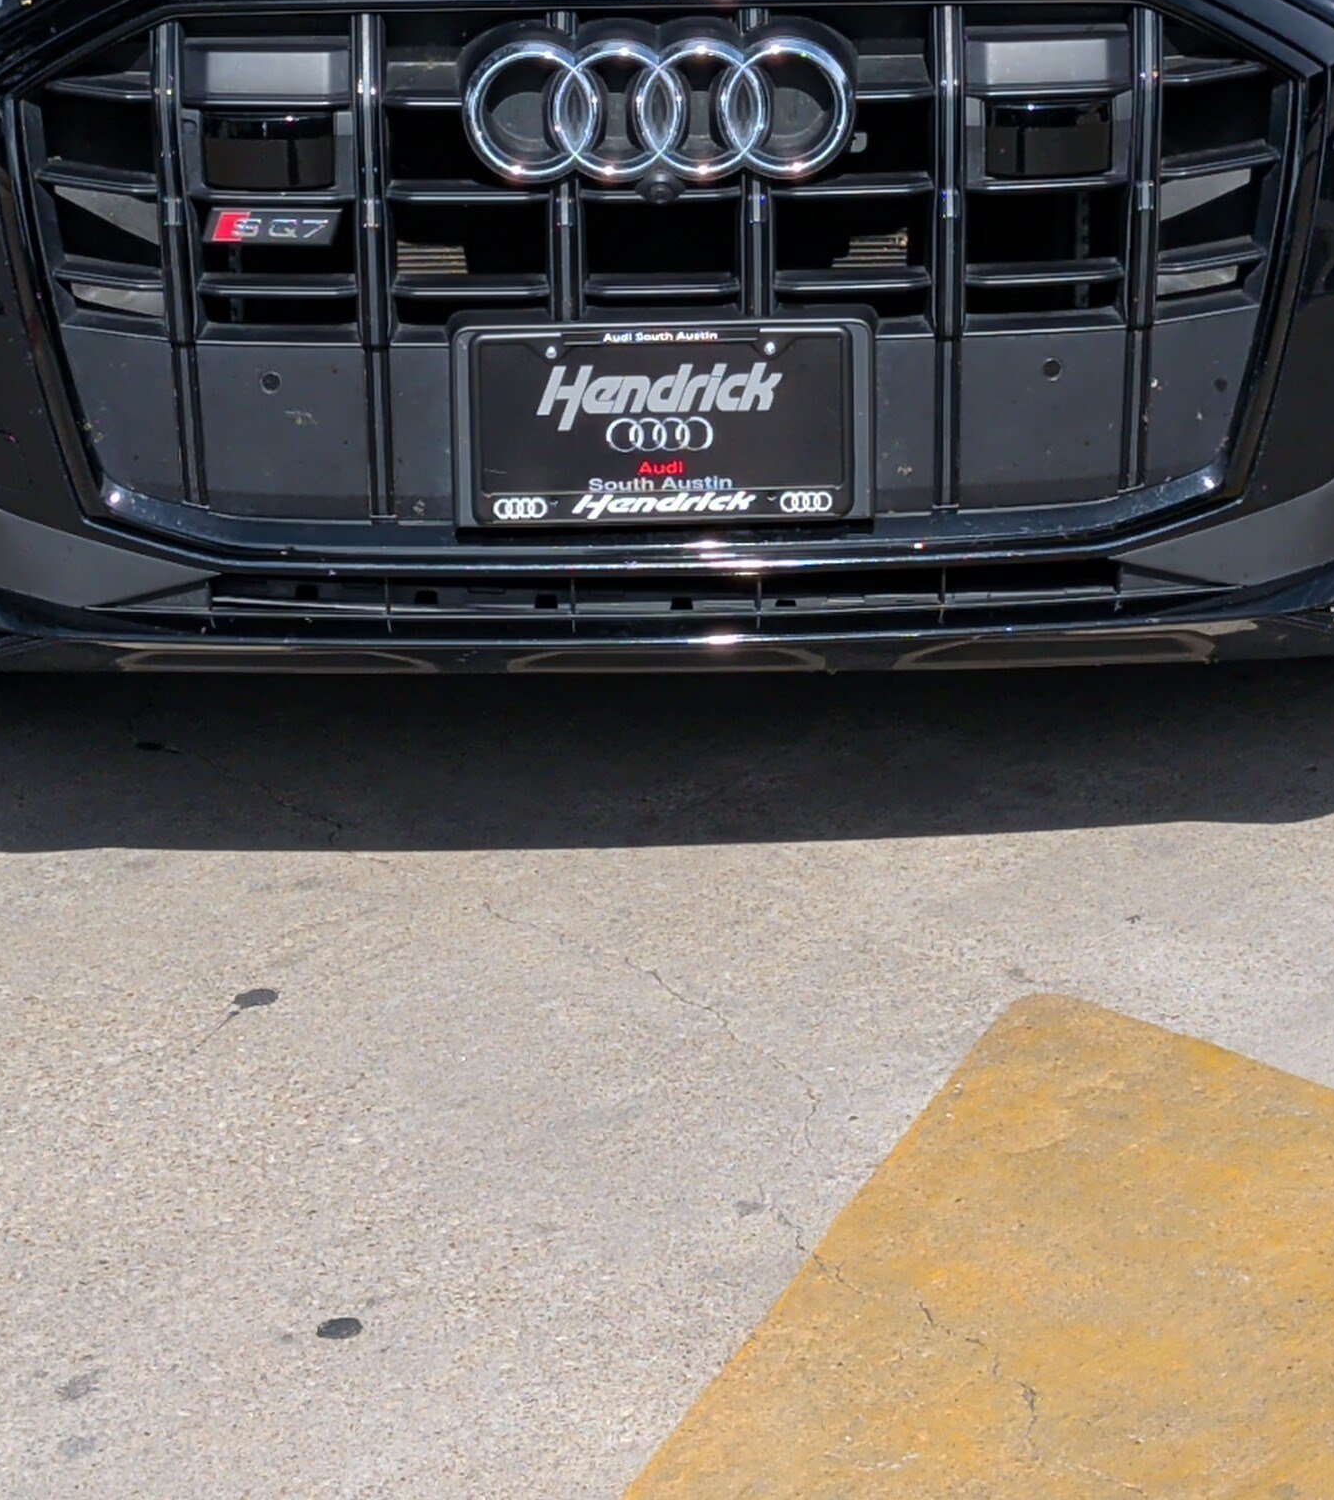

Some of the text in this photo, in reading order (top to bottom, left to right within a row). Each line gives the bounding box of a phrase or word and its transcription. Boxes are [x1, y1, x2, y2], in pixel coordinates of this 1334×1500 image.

[231, 218, 329, 238] SQ7
[603, 331, 718, 342] Audi South Austin
[535, 362, 783, 431] Hendrick
[638, 461, 683, 475] Audi
[588, 475, 733, 491] South Austin
[571, 490, 757, 520] Hendrick
